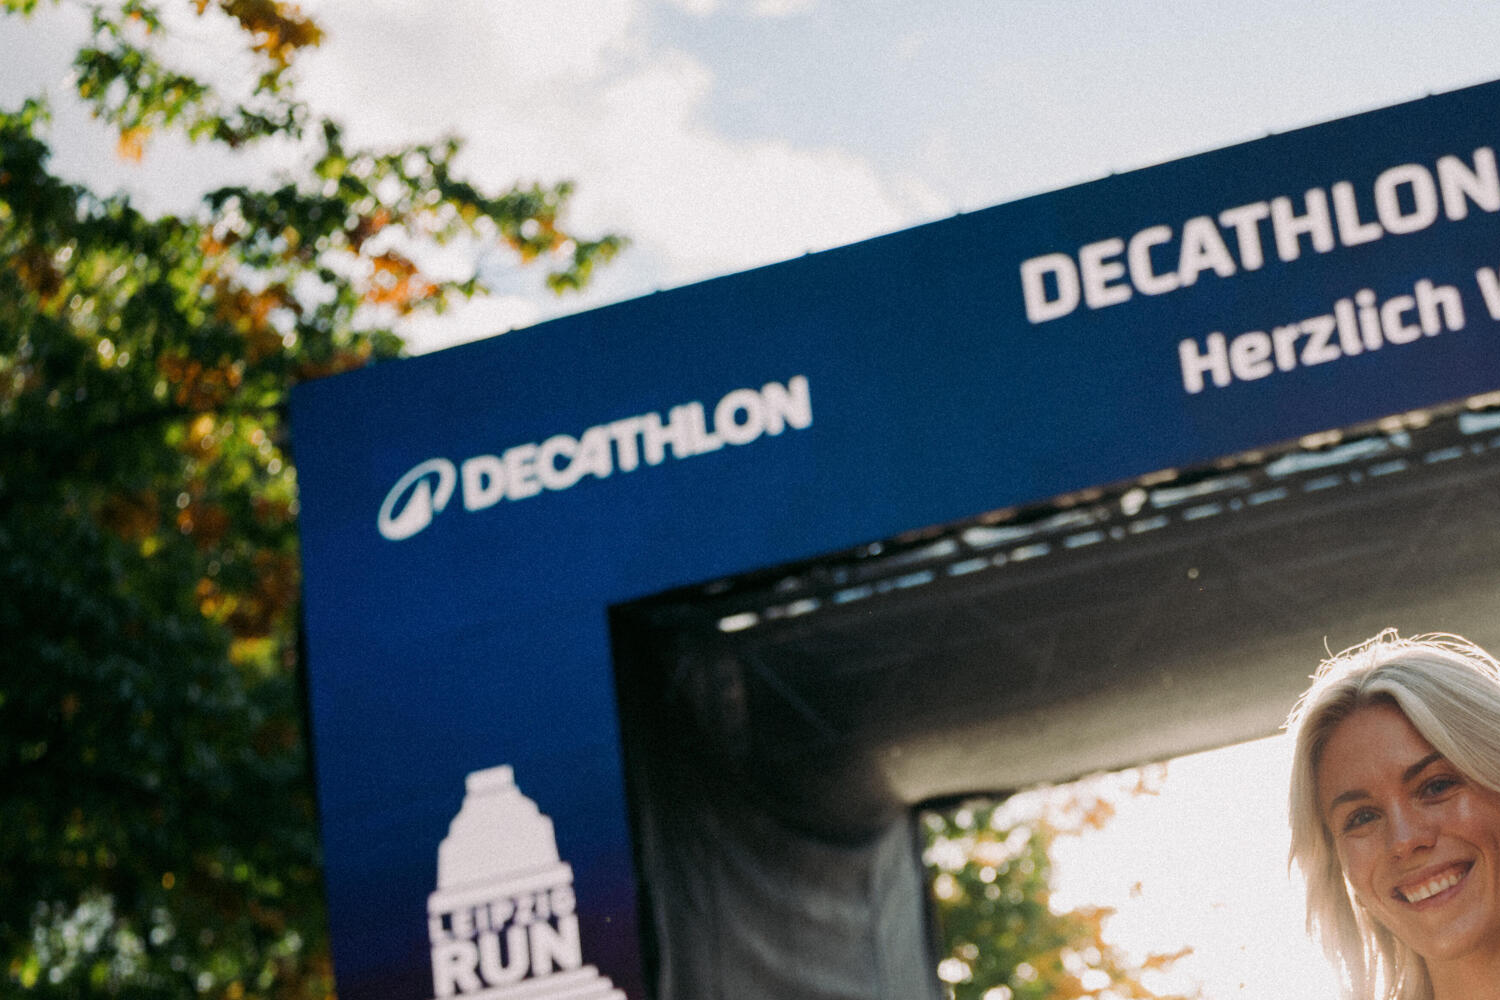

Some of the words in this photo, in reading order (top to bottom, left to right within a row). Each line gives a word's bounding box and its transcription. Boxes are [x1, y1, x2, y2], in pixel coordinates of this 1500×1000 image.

[1178, 277, 1465, 394] Herzlich
[460, 375, 814, 513] DECATHLON
[427, 883, 577, 943] LEIPZIG
[431, 910, 583, 1000] RUN
